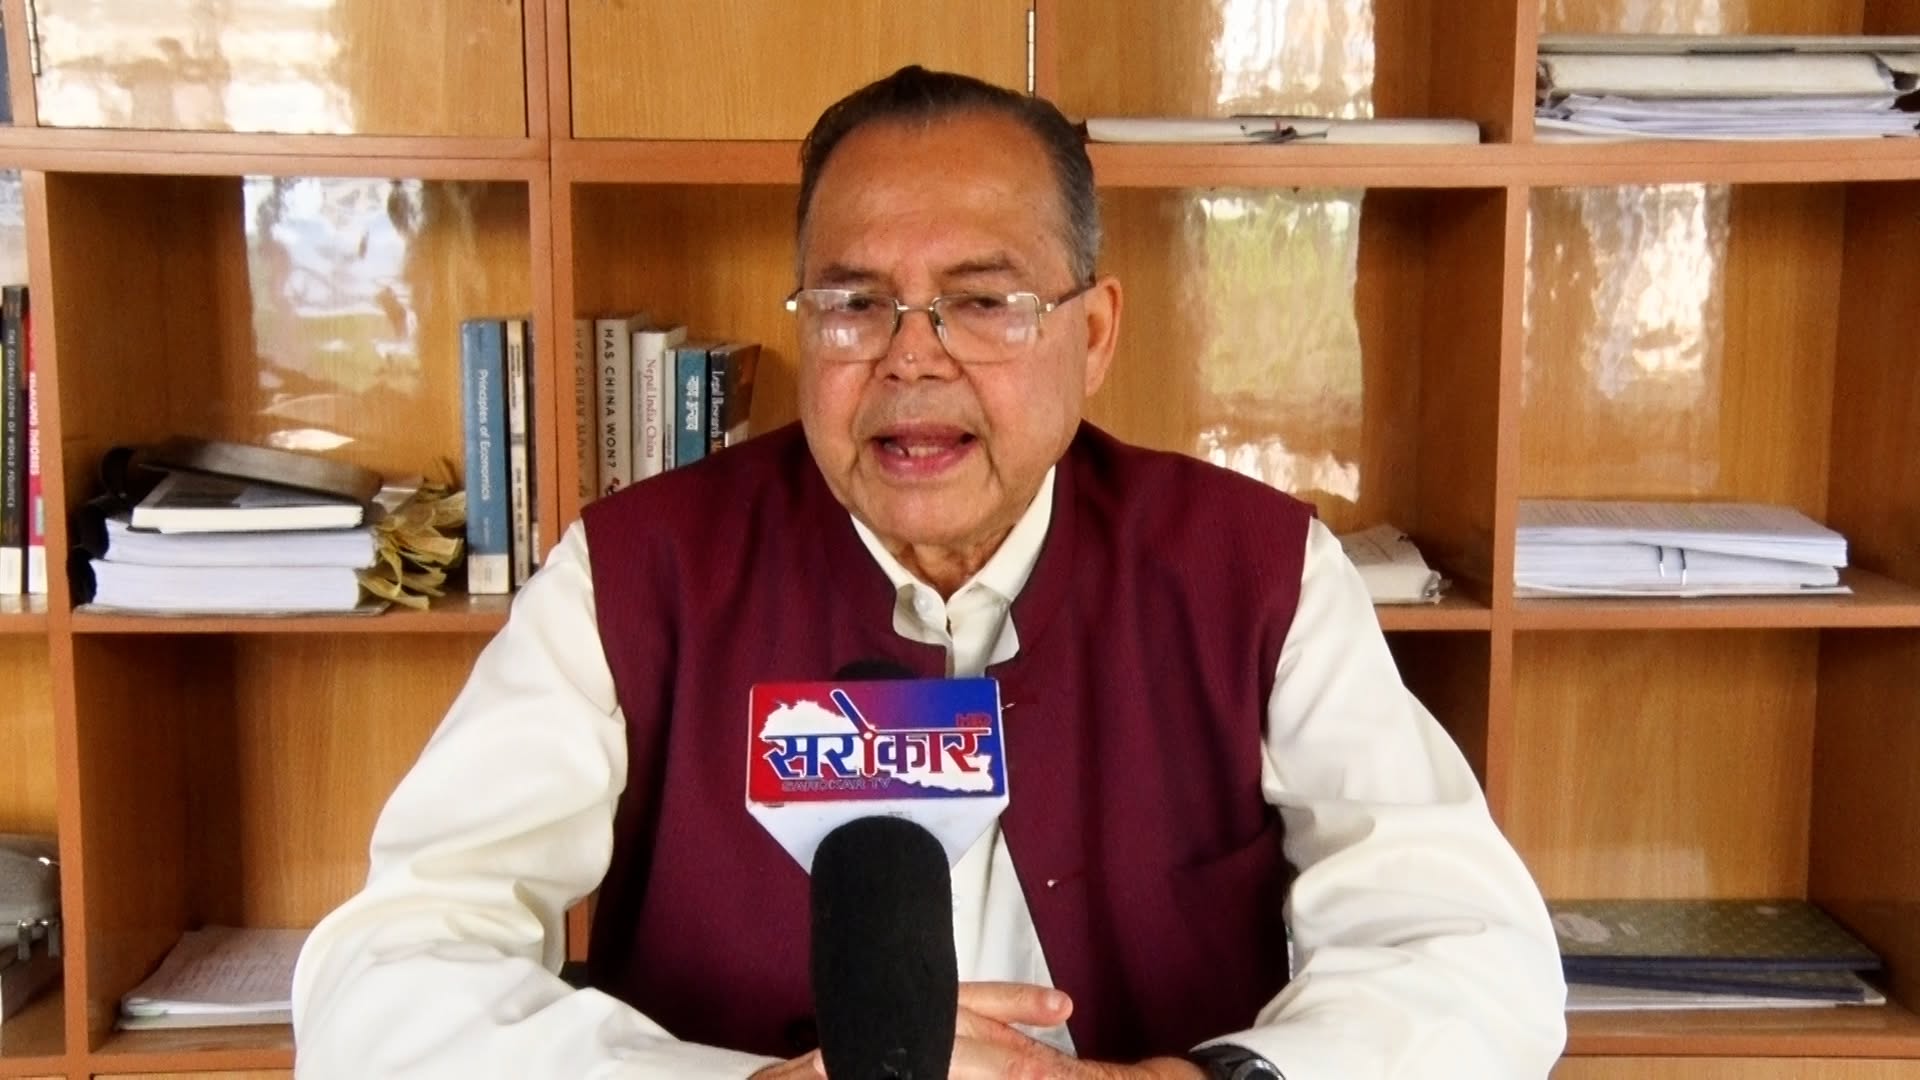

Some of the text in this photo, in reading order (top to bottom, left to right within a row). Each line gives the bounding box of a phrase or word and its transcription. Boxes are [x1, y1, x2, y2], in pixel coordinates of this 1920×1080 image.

[603, 328, 617, 469] HAS CHINA WON?
[711, 370, 725, 395] Legal
[7, 420, 16, 433] OF
[644, 358, 657, 458] Nepal India China
[711, 397, 725, 438] Research
[7, 437, 15, 467] WORLD
[478, 368, 491, 501] Principles of Economics
[763, 689, 992, 780] सरोकार
[870, 777, 892, 790] TV
